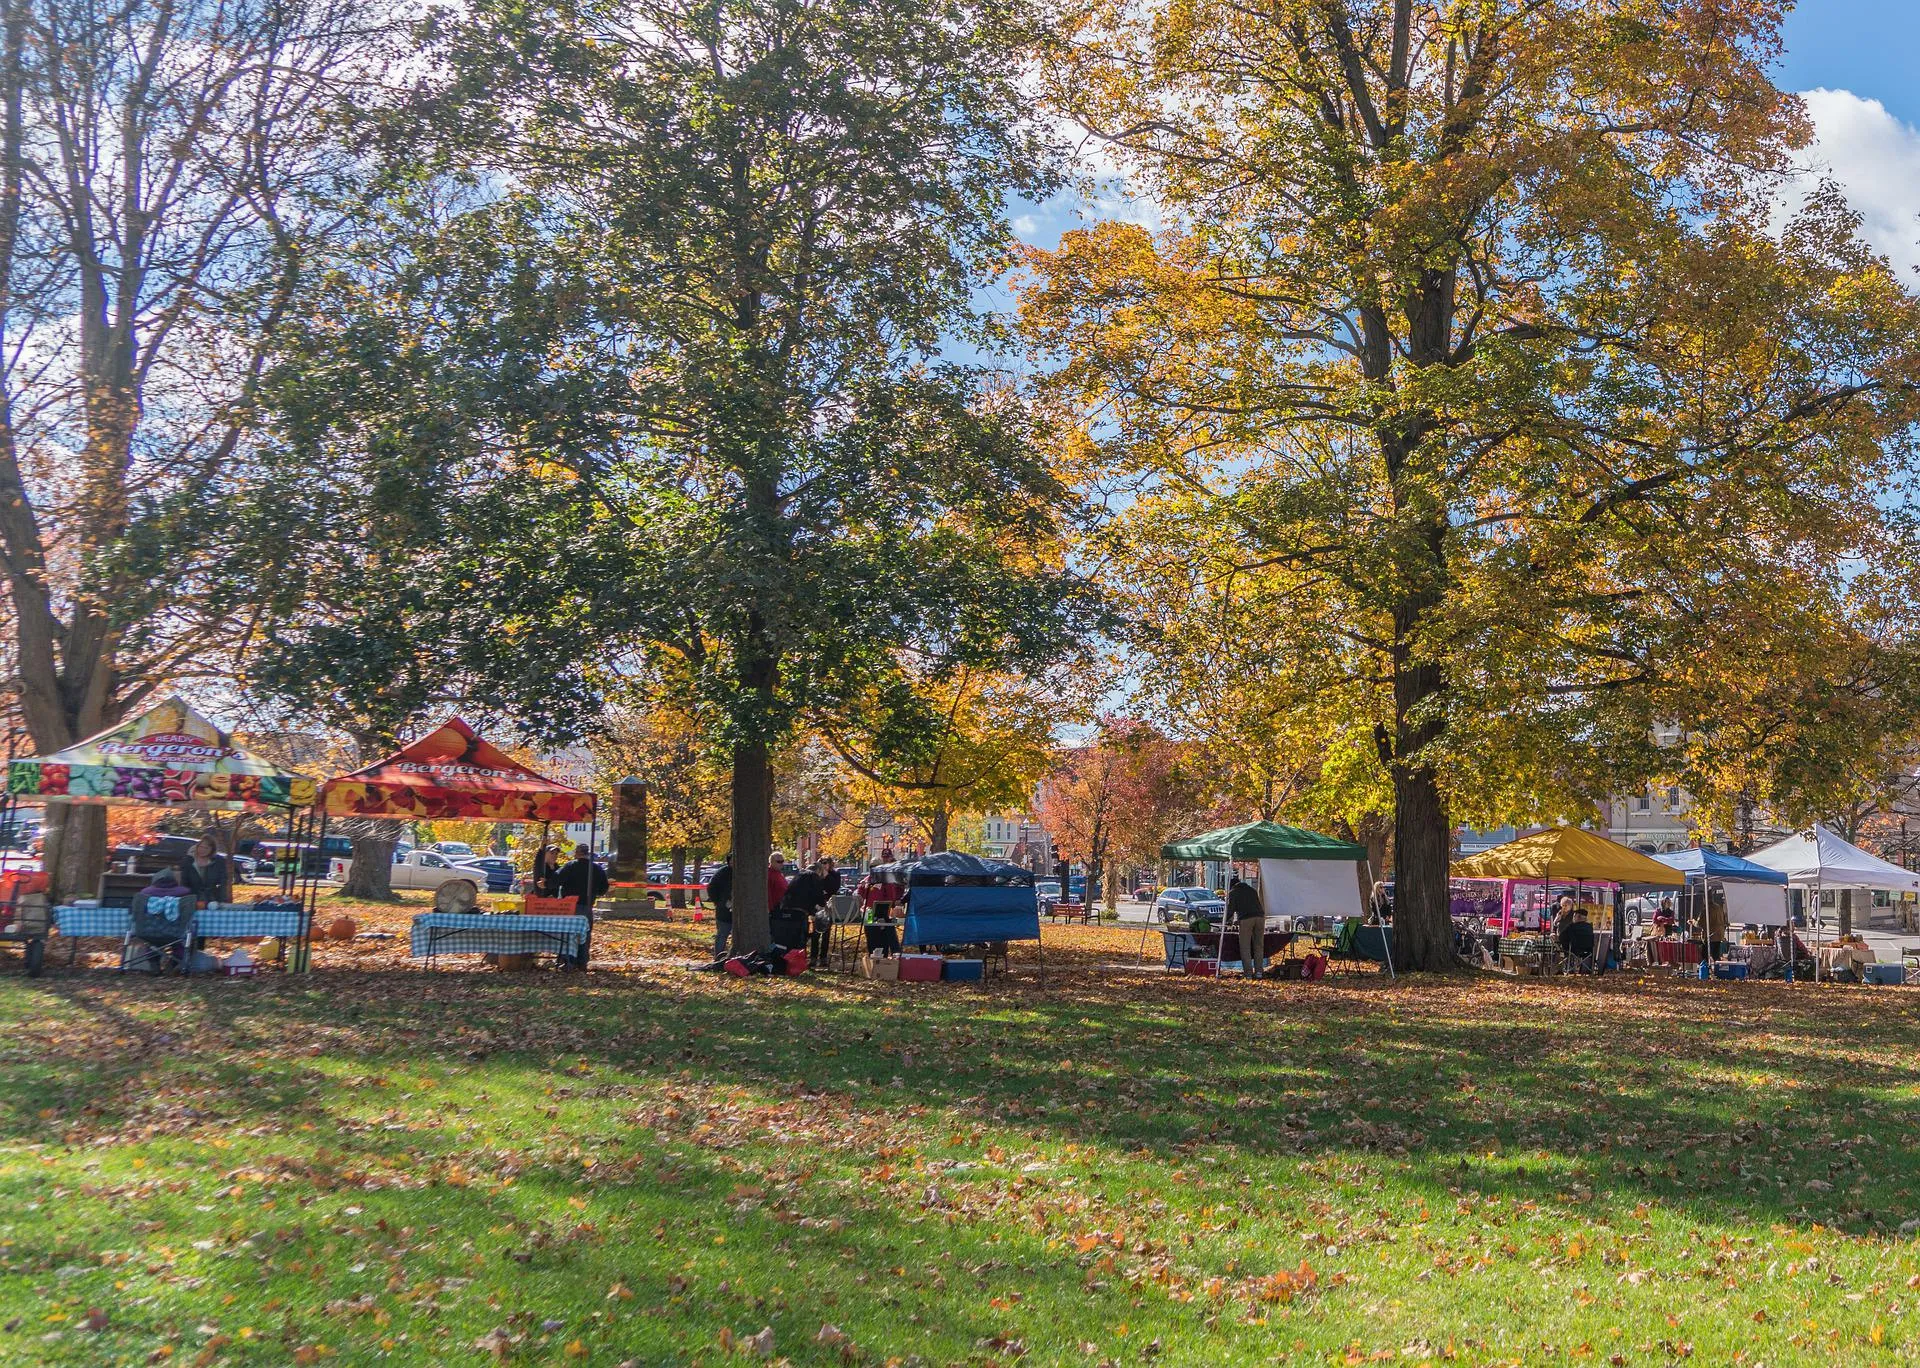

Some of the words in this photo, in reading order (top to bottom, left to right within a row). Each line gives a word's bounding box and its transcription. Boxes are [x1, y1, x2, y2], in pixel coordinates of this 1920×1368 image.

[155, 735, 193, 743] READY
[97, 741, 248, 760] Bergeron's
[397, 761, 529, 780] Bergeron's
